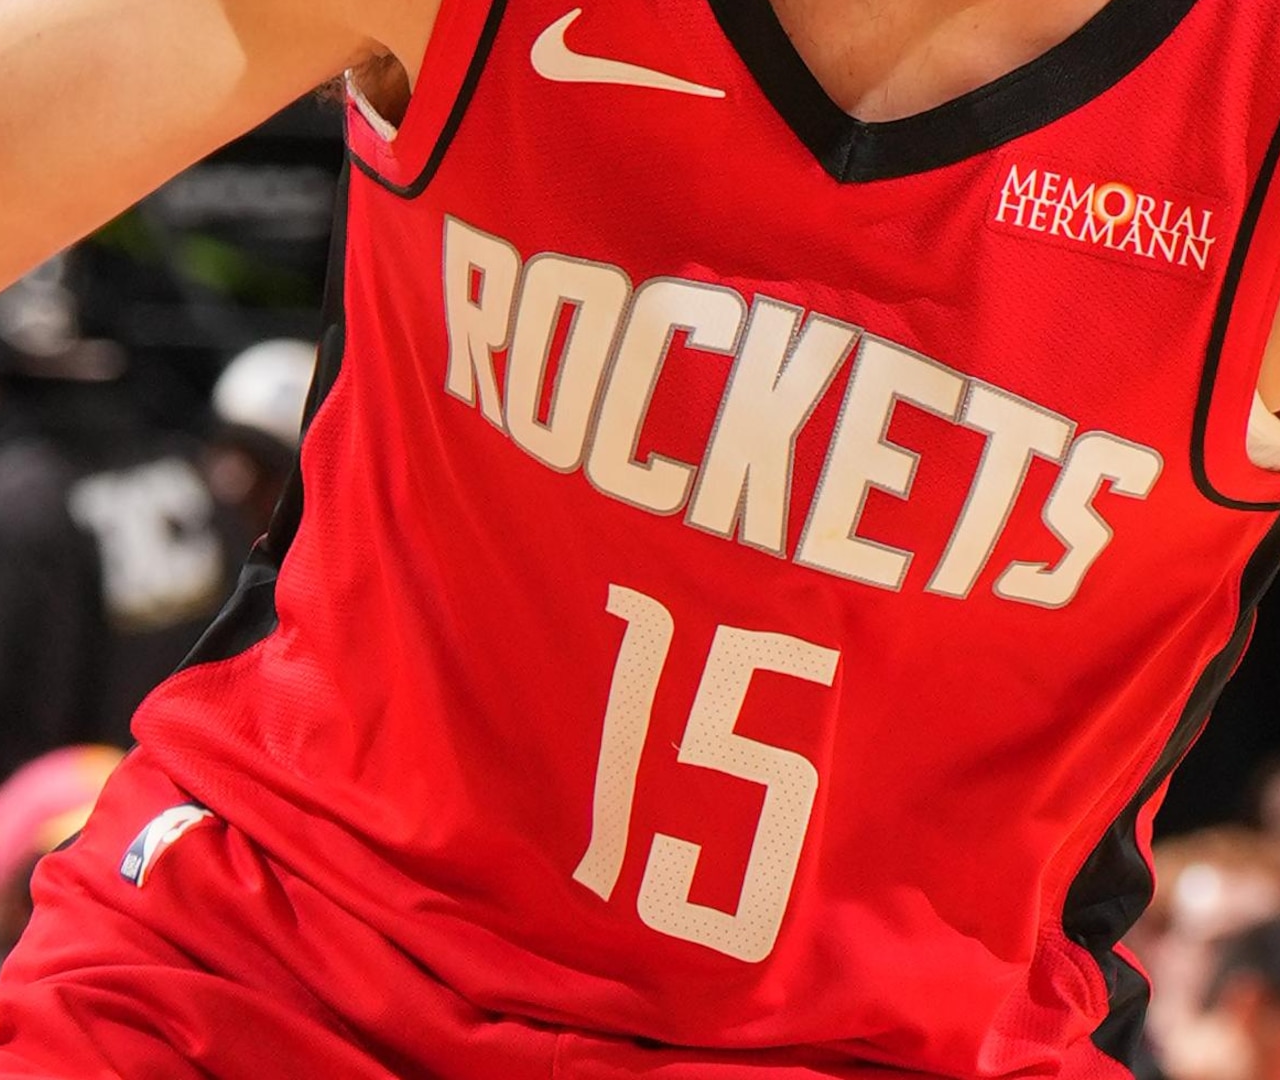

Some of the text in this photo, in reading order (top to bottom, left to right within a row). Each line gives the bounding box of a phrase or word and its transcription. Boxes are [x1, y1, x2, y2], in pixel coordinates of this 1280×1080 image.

[994, 191, 1212, 271] HERMANN
[1001, 164, 1215, 244] MEMORIAL
[442, 214, 1163, 609] ROCKETS
[572, 582, 841, 964] 15
